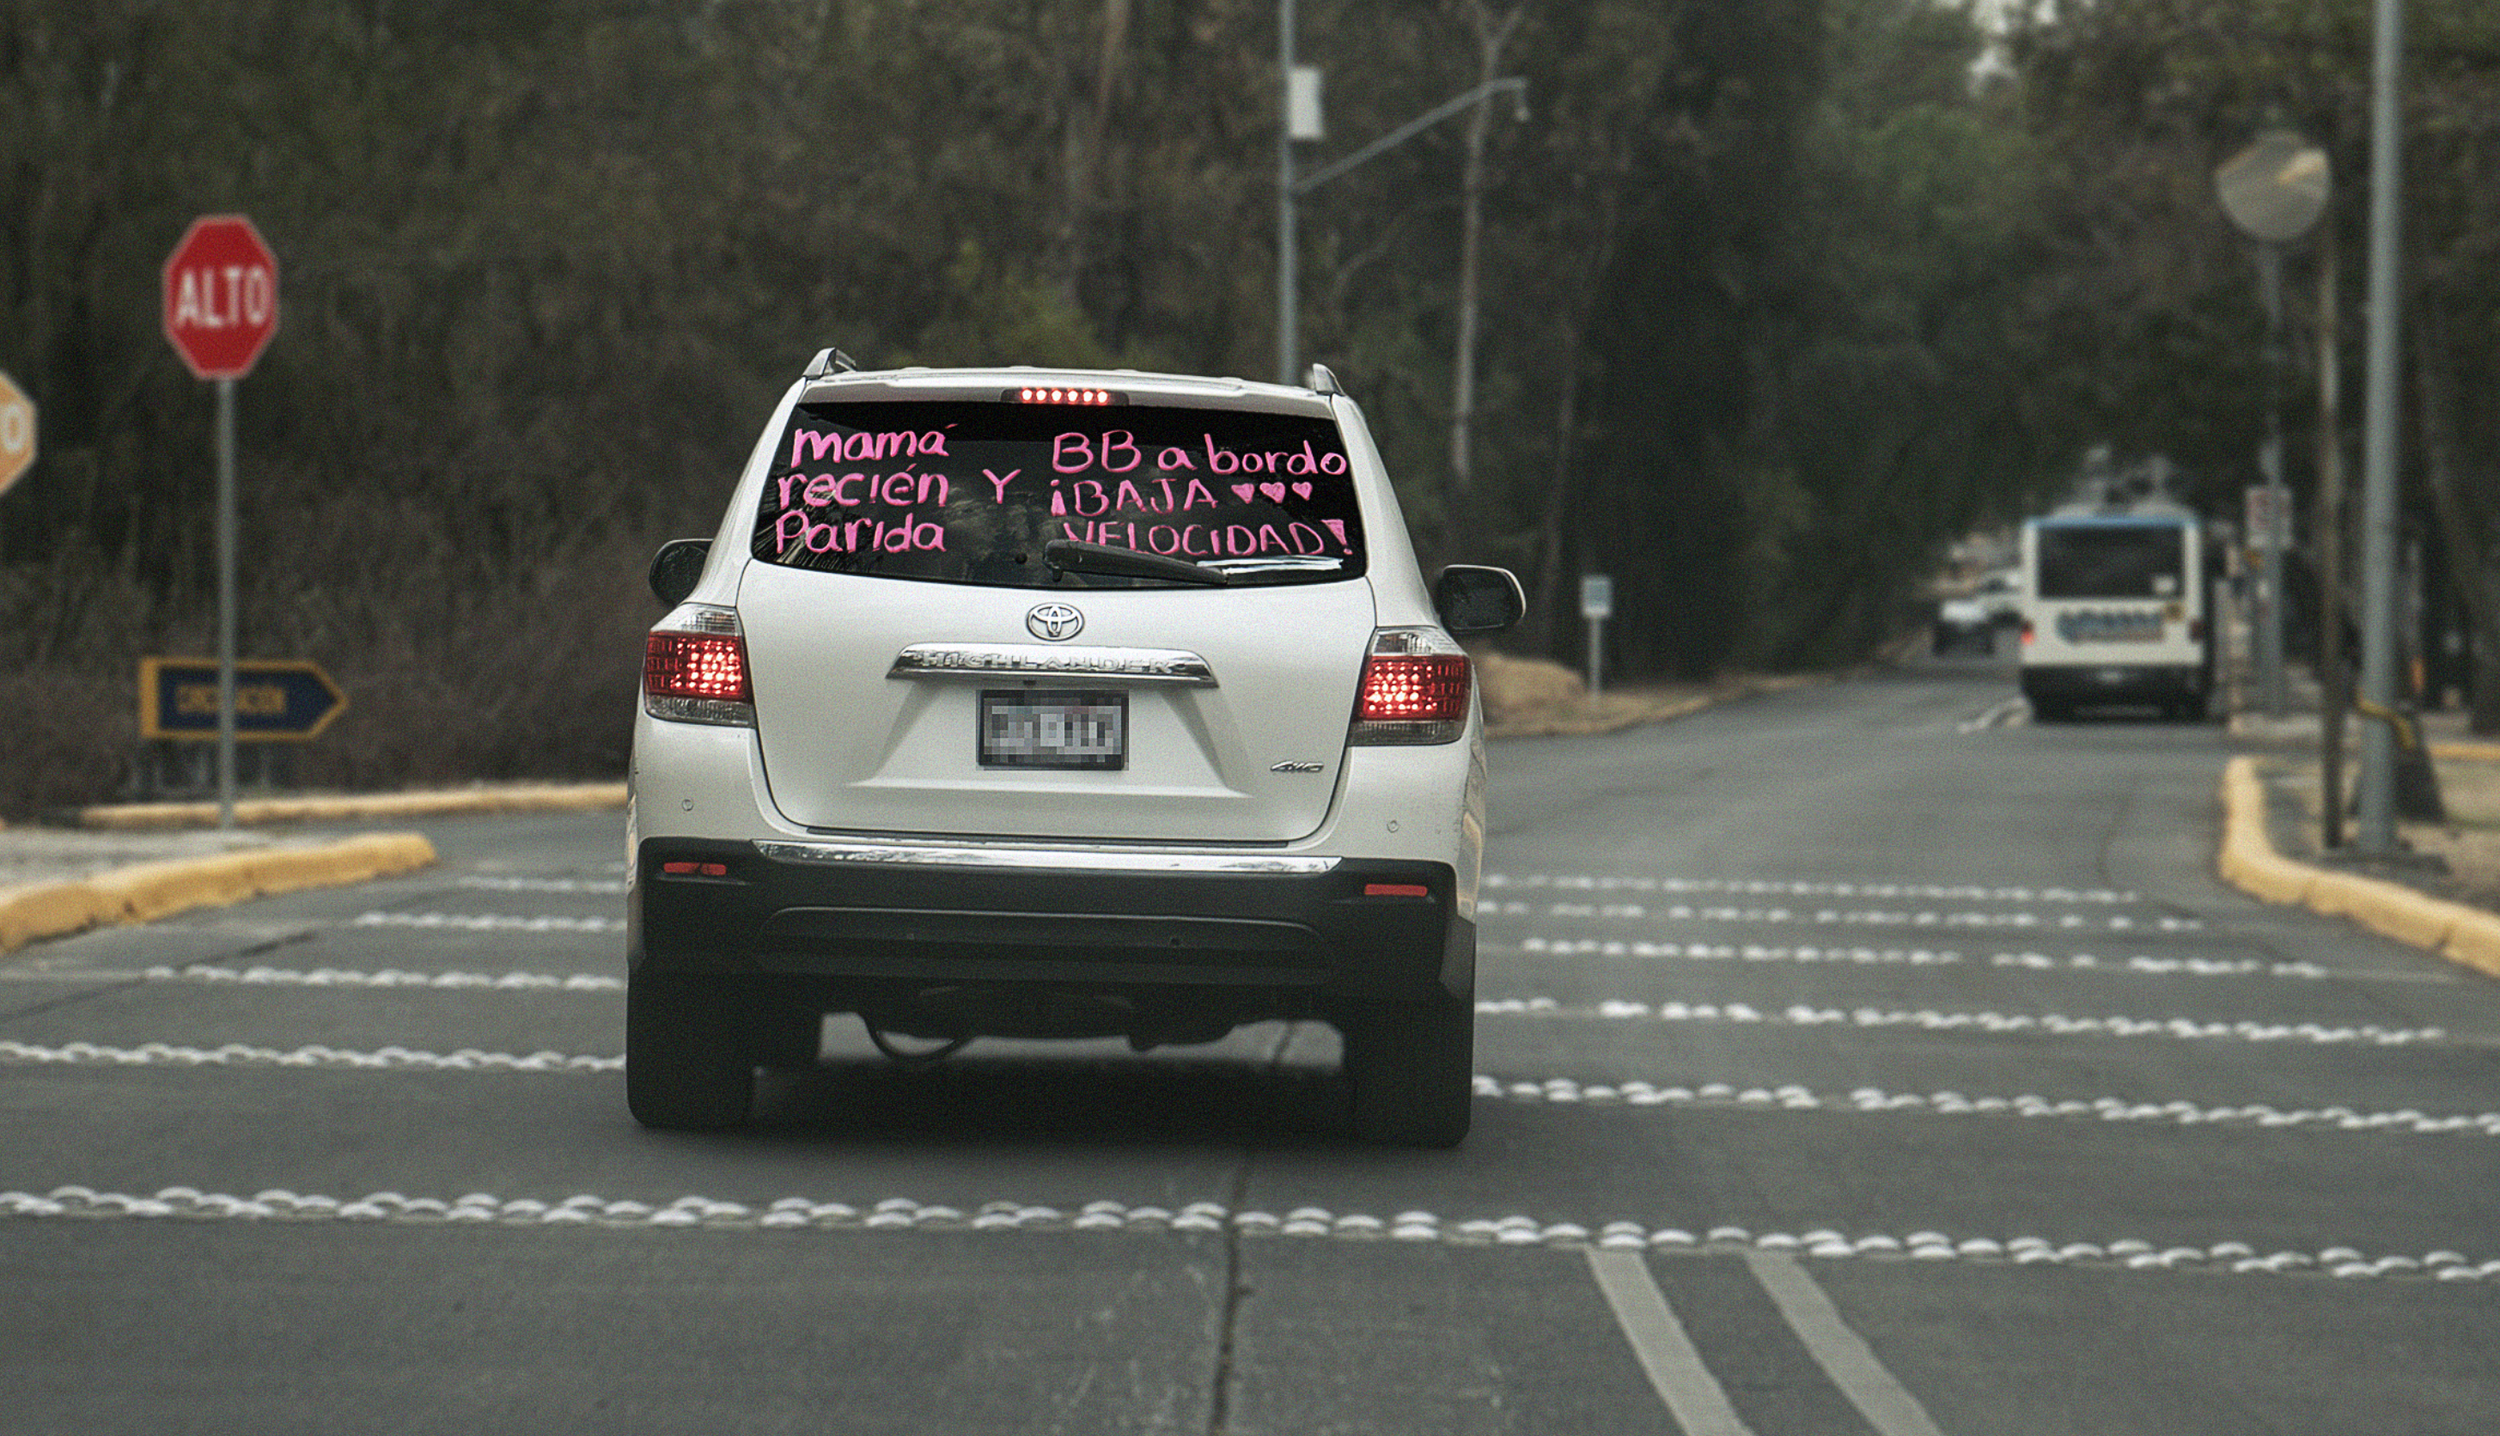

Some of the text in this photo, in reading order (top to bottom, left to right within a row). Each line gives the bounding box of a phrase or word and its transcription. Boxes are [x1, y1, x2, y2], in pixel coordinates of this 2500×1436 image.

[175, 266, 271, 326] ALTO
[790, 423, 959, 469] mamá
[1051, 429, 1348, 476] BB a bordo
[777, 462, 950, 510] recién
[1050, 478, 1219, 517] ¡BAJA
[1062, 518, 1354, 556] VELOCIDAD!
[921, 651, 1175, 674] HIGHLANDER
